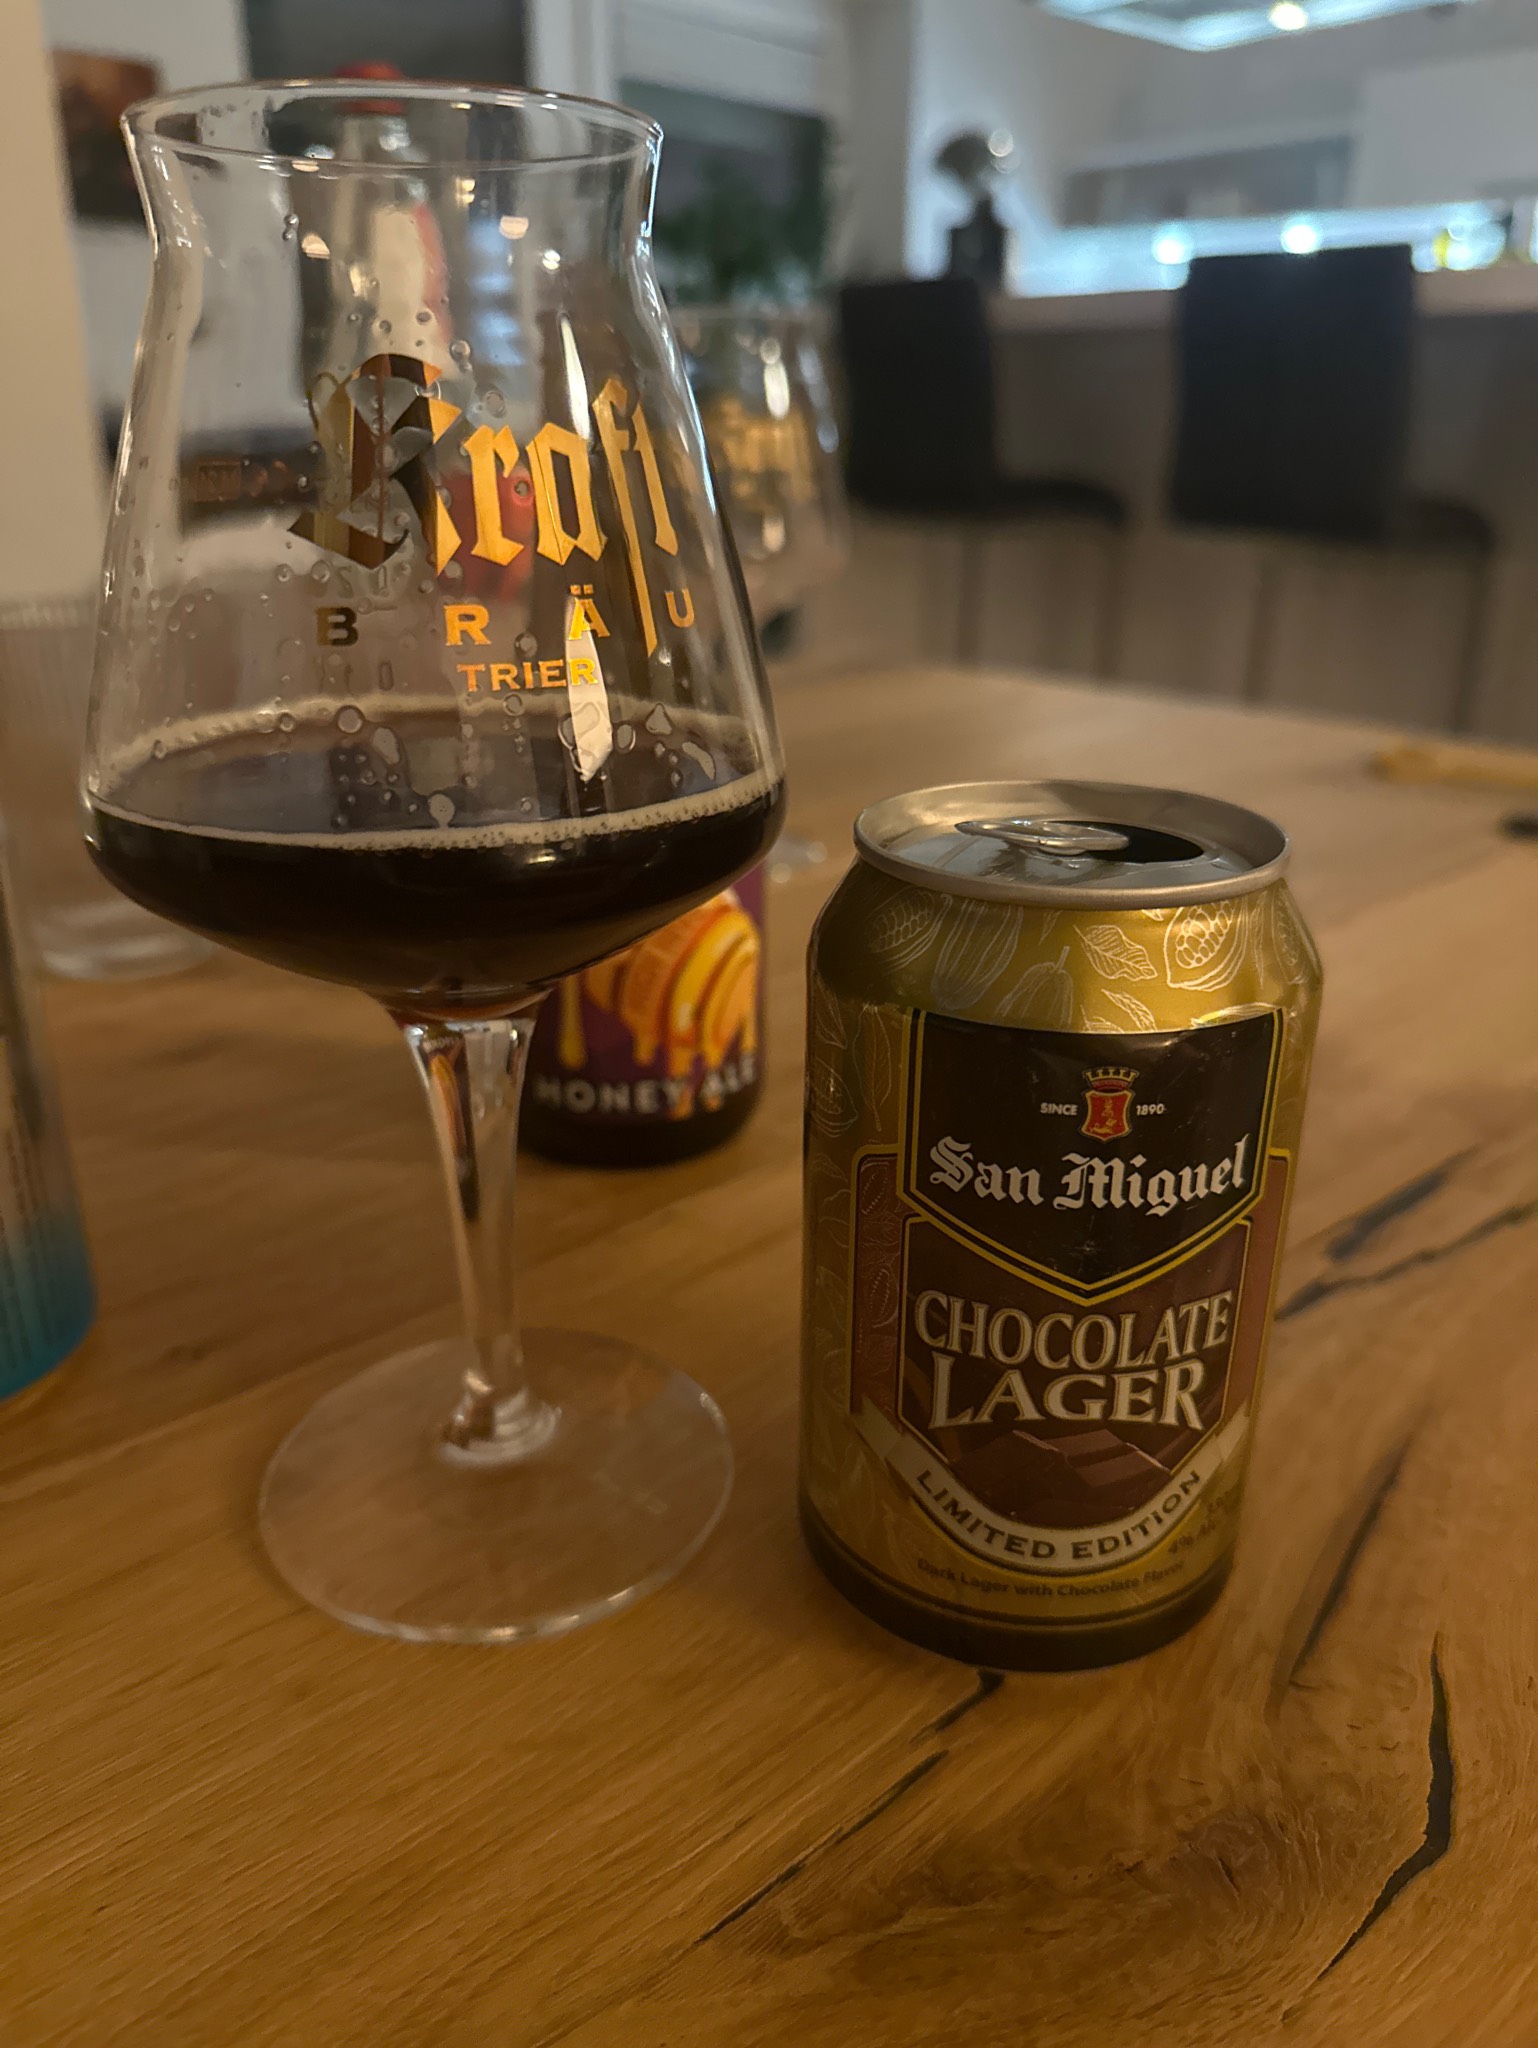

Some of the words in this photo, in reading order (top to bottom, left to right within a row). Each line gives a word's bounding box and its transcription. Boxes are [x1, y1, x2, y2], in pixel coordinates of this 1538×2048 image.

[314, 584, 695, 648] BRÄU
[457, 657, 599, 694] TRIER
[532, 1075, 687, 1113] HONEY
[1040, 1102, 1078, 1116] SINCE
[1135, 1103, 1165, 1116] 1890
[929, 1135, 1045, 1206] San
[1053, 1133, 1250, 1216] Miguel
[914, 1289, 1233, 1371] CHOCOLATE
[928, 1351, 1205, 1431] LAGER
[916, 1469, 1056, 1560] LIMITED
[1070, 1470, 1199, 1560] EDITION
[916, 1557, 957, 1582] Dark
[959, 1571, 1010, 1594] Lager
[1013, 1582, 1053, 1597] with
[1056, 1576, 1141, 1598] Chocolate
